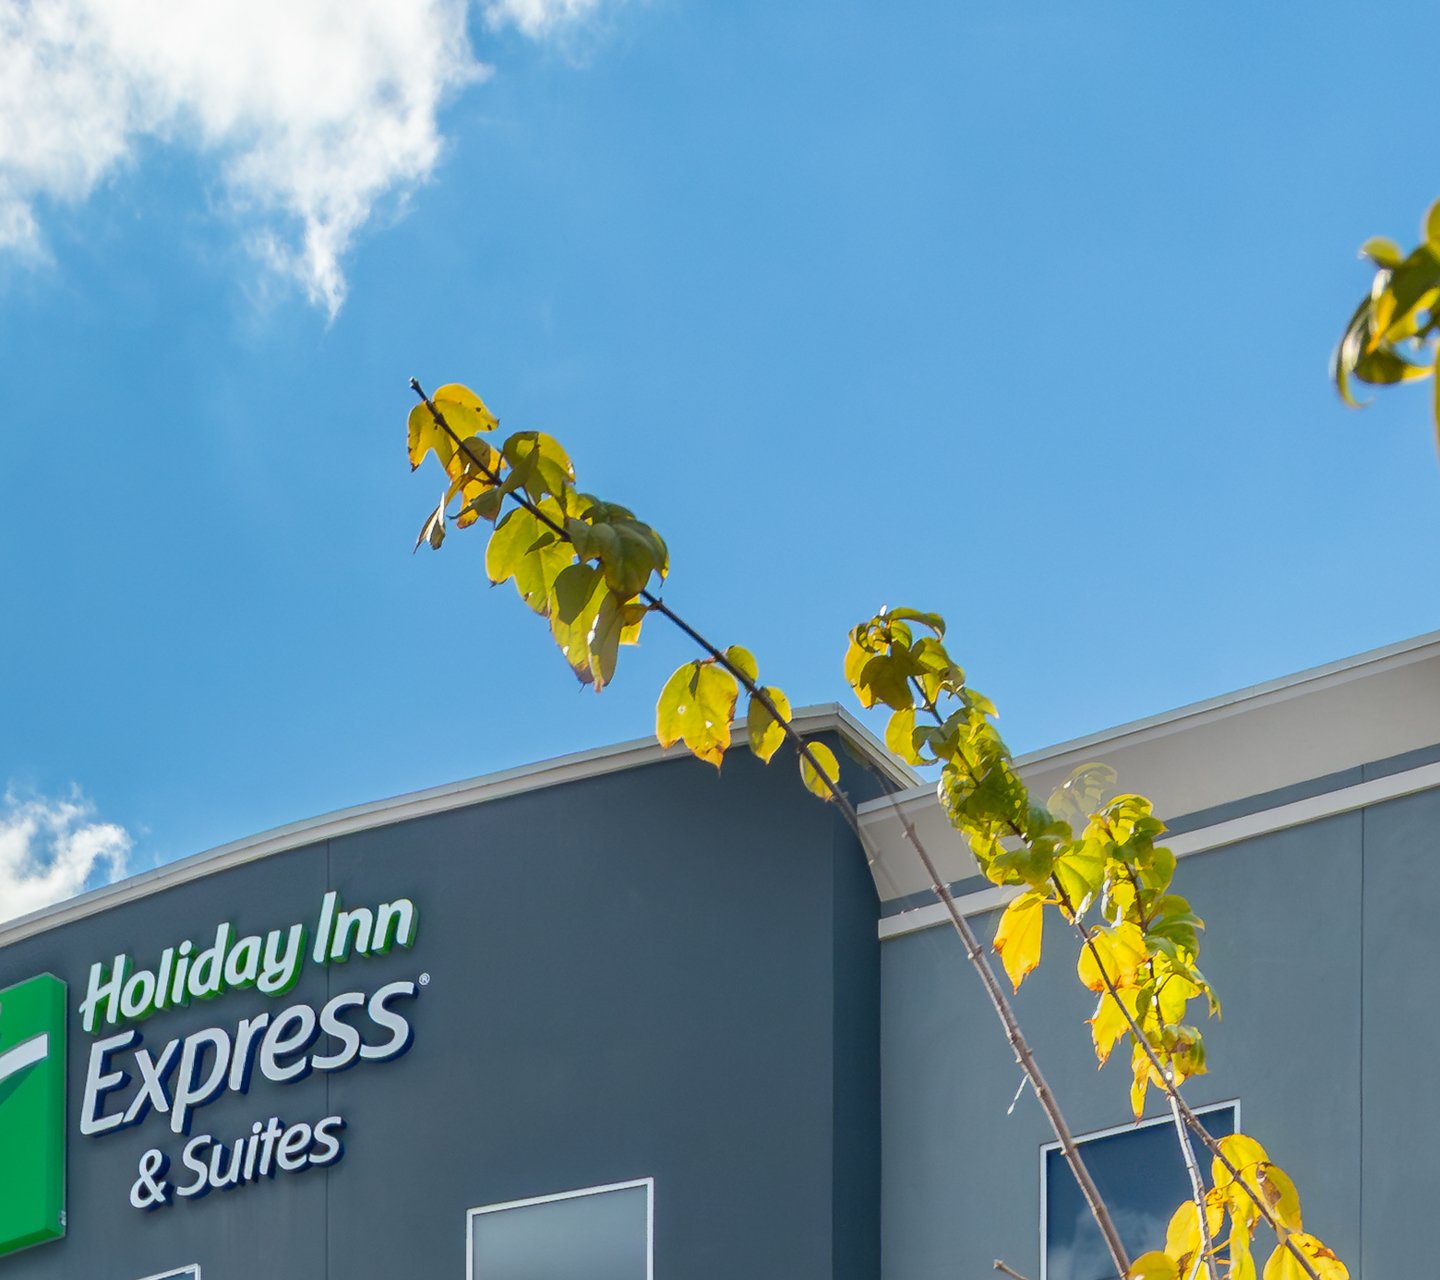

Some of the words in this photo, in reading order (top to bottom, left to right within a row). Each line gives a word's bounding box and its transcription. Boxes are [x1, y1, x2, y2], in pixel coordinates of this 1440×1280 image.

[79, 922, 303, 1033] Holiday
[313, 891, 416, 964] Inn
[79, 981, 416, 1135] Express
[130, 1148, 167, 1210] &
[176, 1115, 343, 1199] Suites
